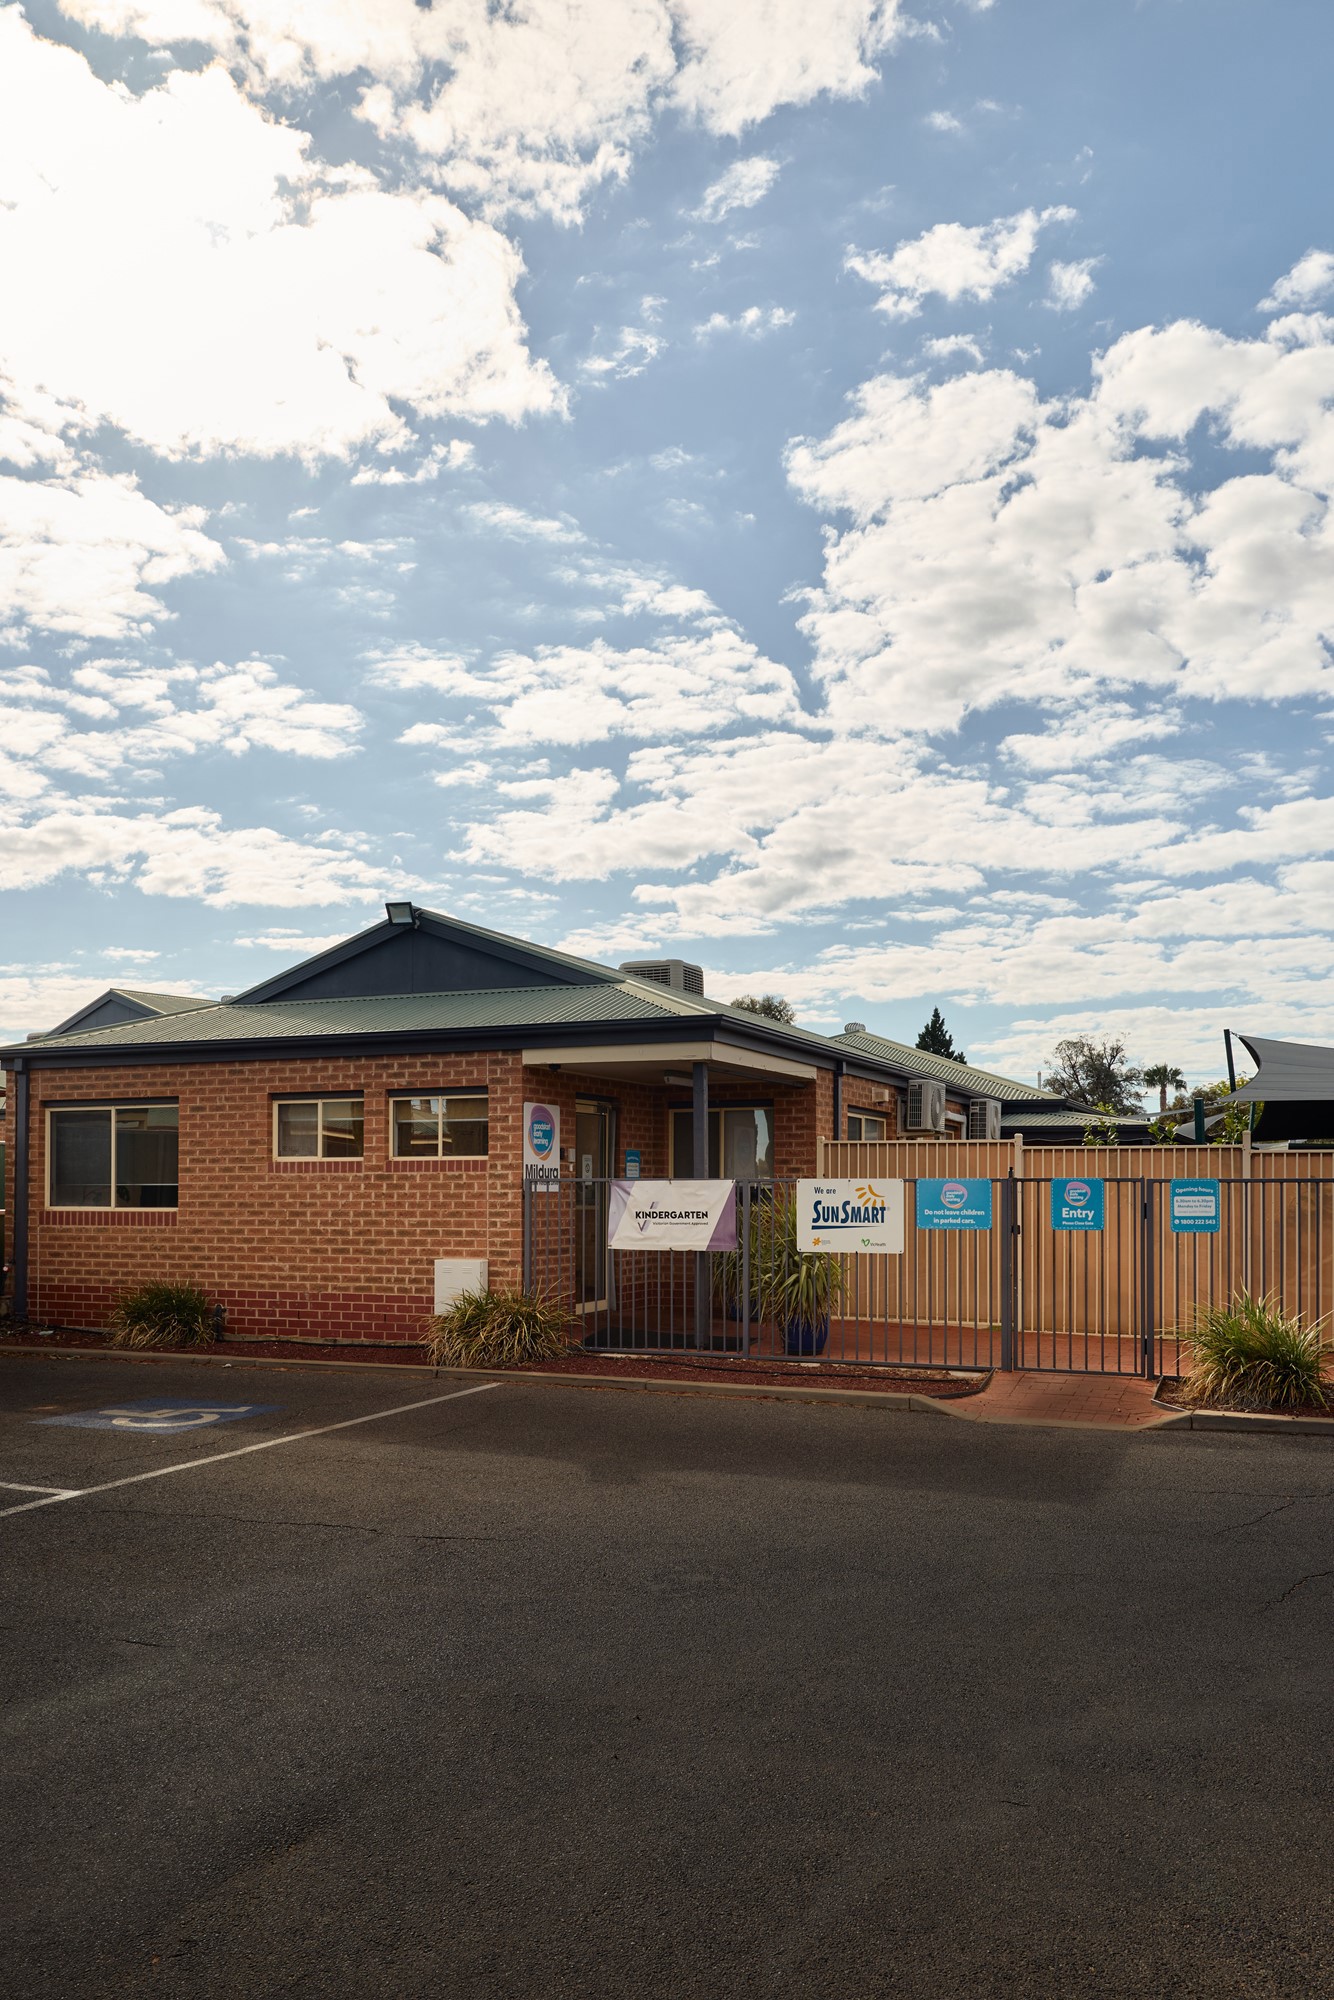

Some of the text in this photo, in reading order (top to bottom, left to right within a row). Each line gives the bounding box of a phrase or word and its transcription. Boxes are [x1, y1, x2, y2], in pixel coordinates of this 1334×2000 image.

[525, 1163, 559, 1179] Mildura
[814, 1186, 837, 1195] We are
[635, 1210, 709, 1219] KINDERGARTEN
[1062, 1207, 1095, 1221] Entry
[940, 1217, 961, 1225] parked
